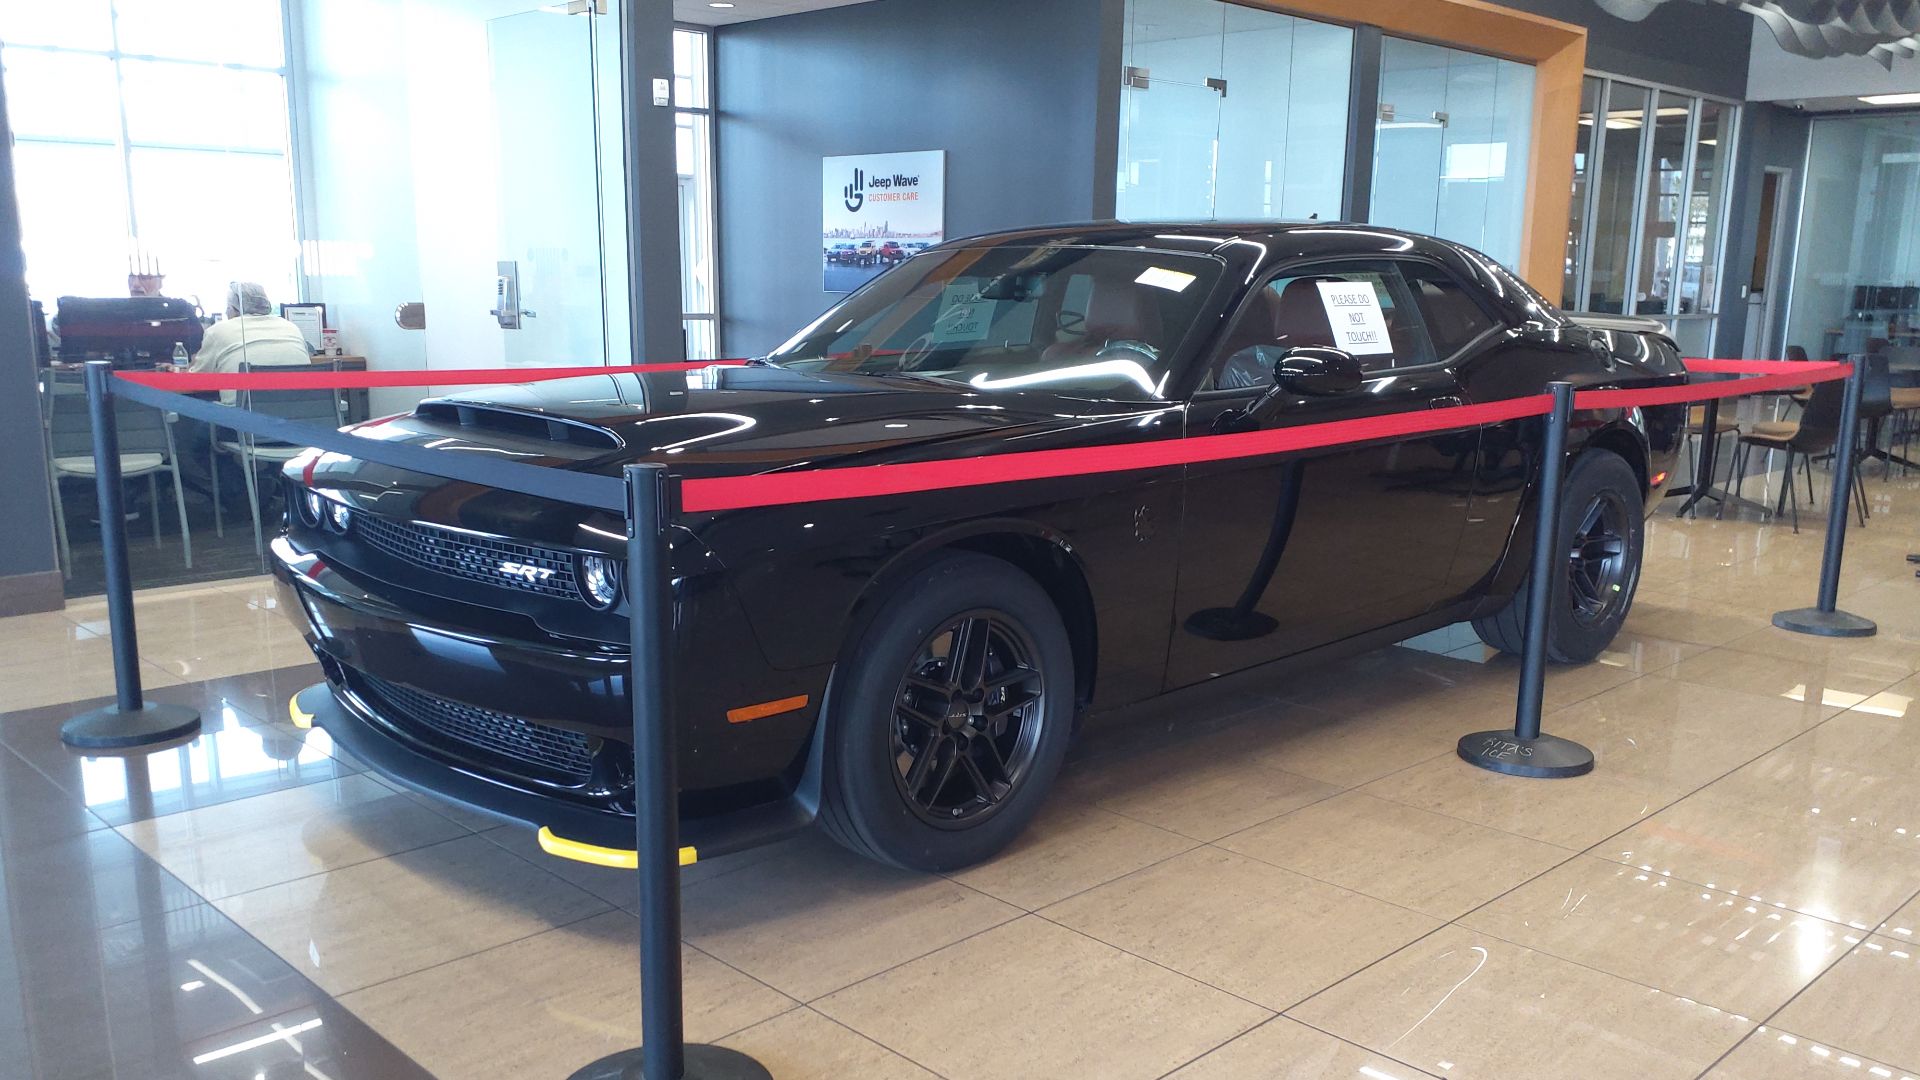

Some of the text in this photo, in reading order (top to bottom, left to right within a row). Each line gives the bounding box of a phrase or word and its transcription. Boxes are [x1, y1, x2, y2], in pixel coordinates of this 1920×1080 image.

[868, 174, 919, 190] Jeep Wave
[868, 191, 919, 202] CUSTOMER CARE
[1330, 293, 1370, 304] PLEASE DO
[1348, 312, 1365, 322] NOT
[1346, 331, 1378, 342] TOUCH!!
[499, 561, 557, 582] SRT
[1481, 747, 1511, 760] ICE
